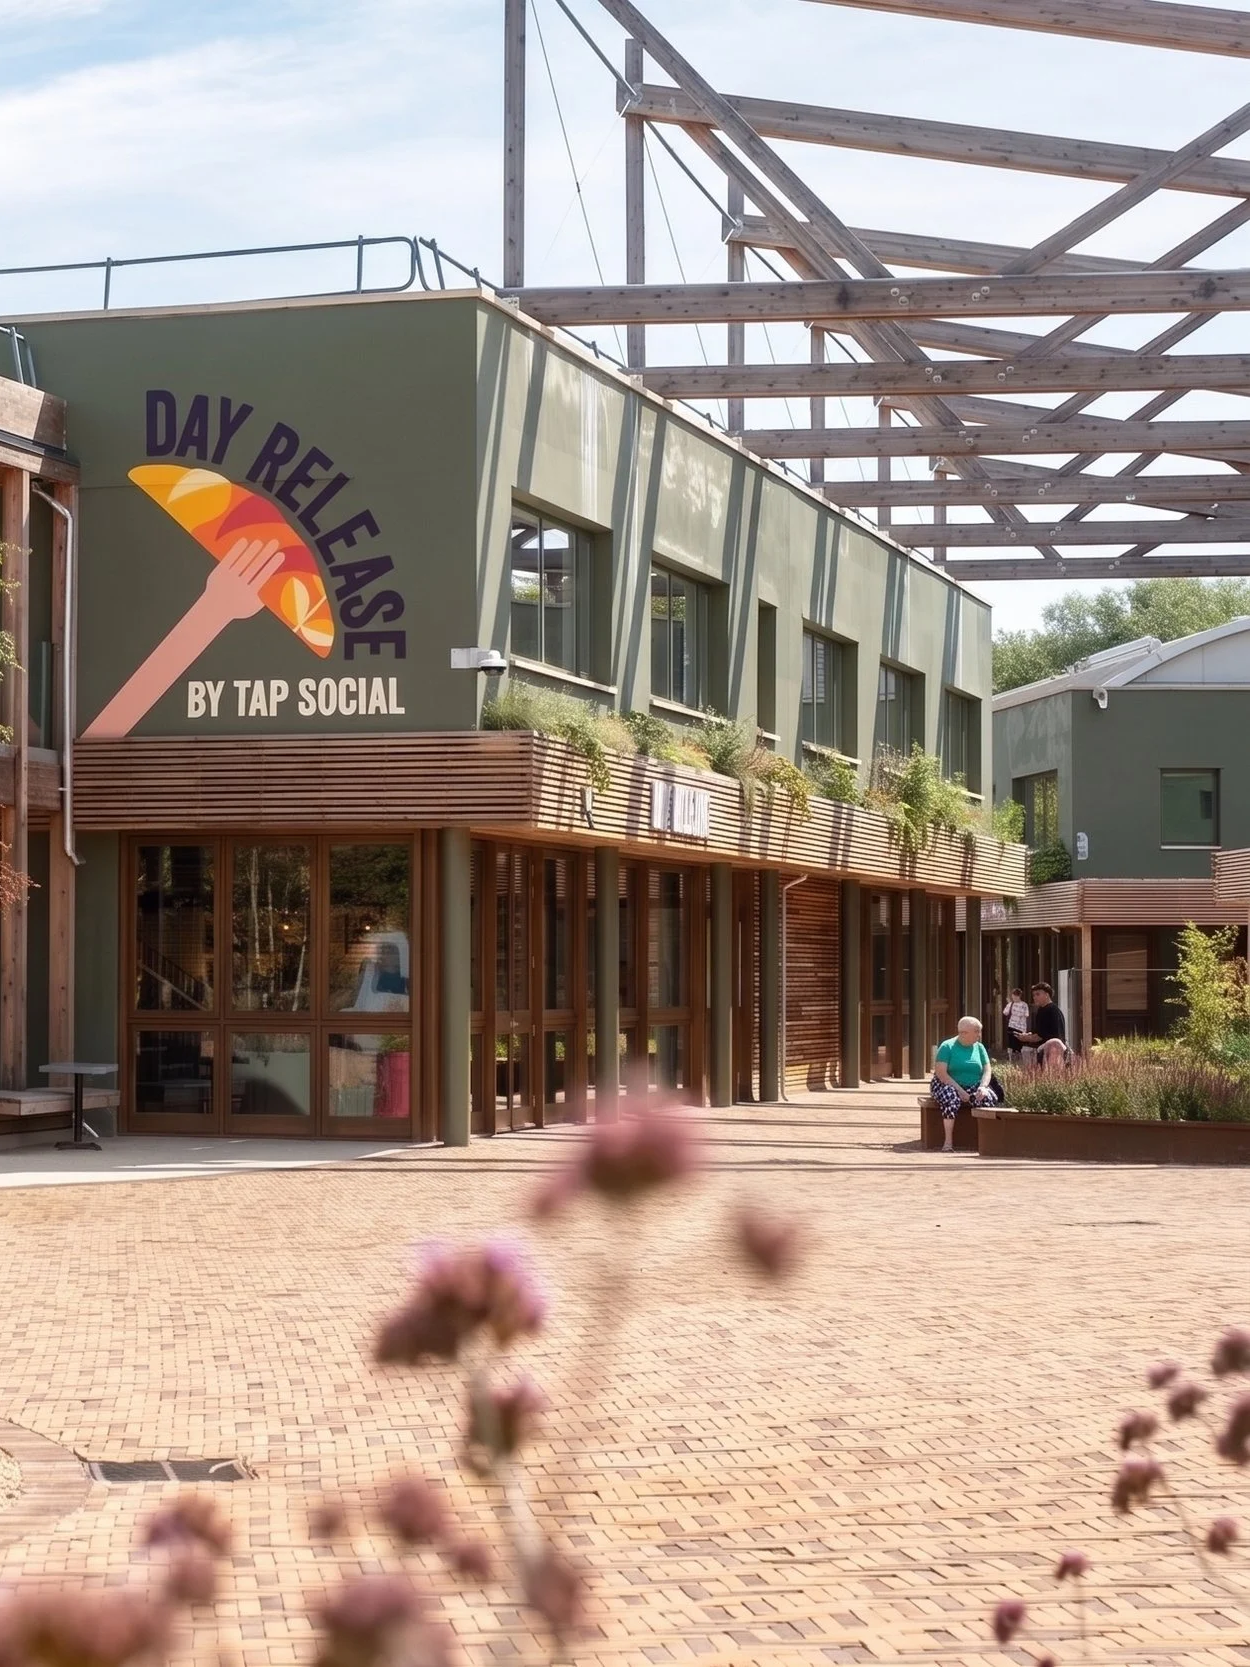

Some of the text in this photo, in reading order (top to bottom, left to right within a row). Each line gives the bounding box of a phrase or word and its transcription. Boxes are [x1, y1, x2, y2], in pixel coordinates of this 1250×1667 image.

[146, 390, 406, 661] DAY RELEASE
[187, 677, 405, 718] BY TAP SOCIAL
